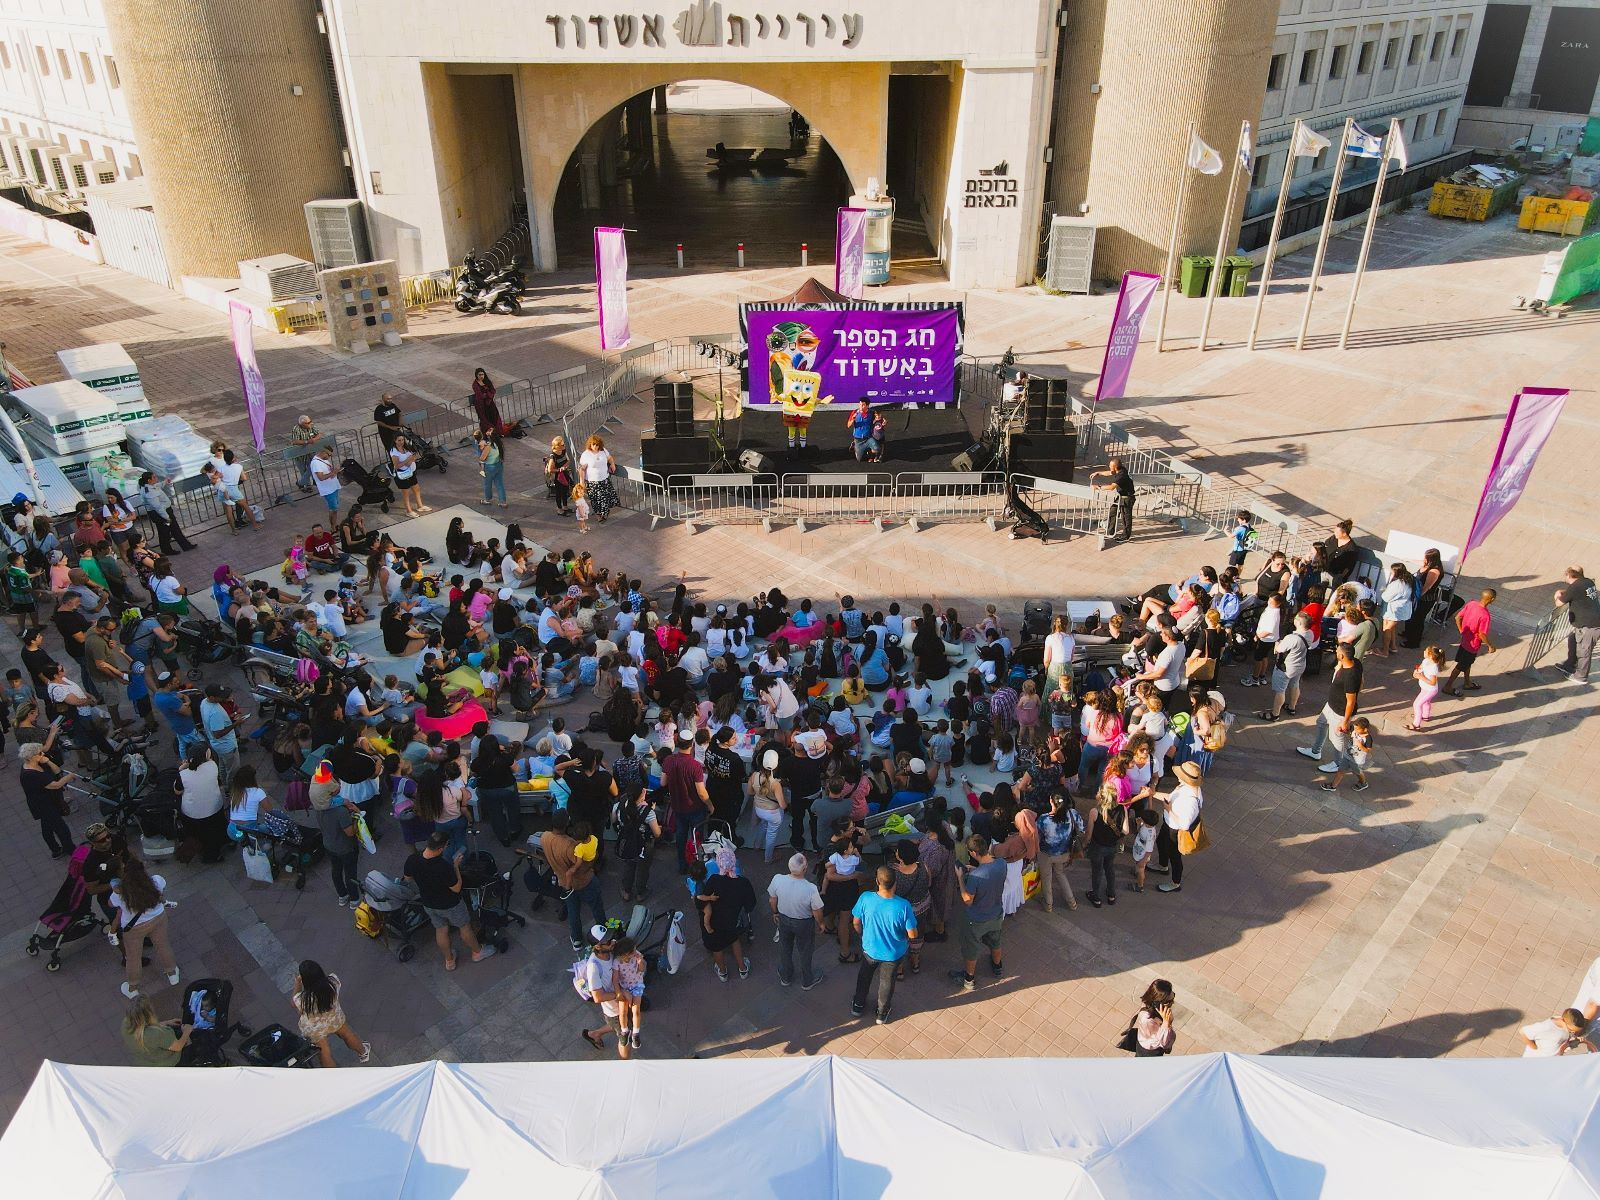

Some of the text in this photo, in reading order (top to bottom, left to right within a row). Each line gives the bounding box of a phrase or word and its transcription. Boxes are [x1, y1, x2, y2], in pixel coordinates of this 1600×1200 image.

[545, 13, 864, 50] עיריית אשדוד
[1560, 41, 1590, 49] ZARA
[965, 179, 1018, 193] ברוכים
[963, 194, 1017, 208] הבאים
